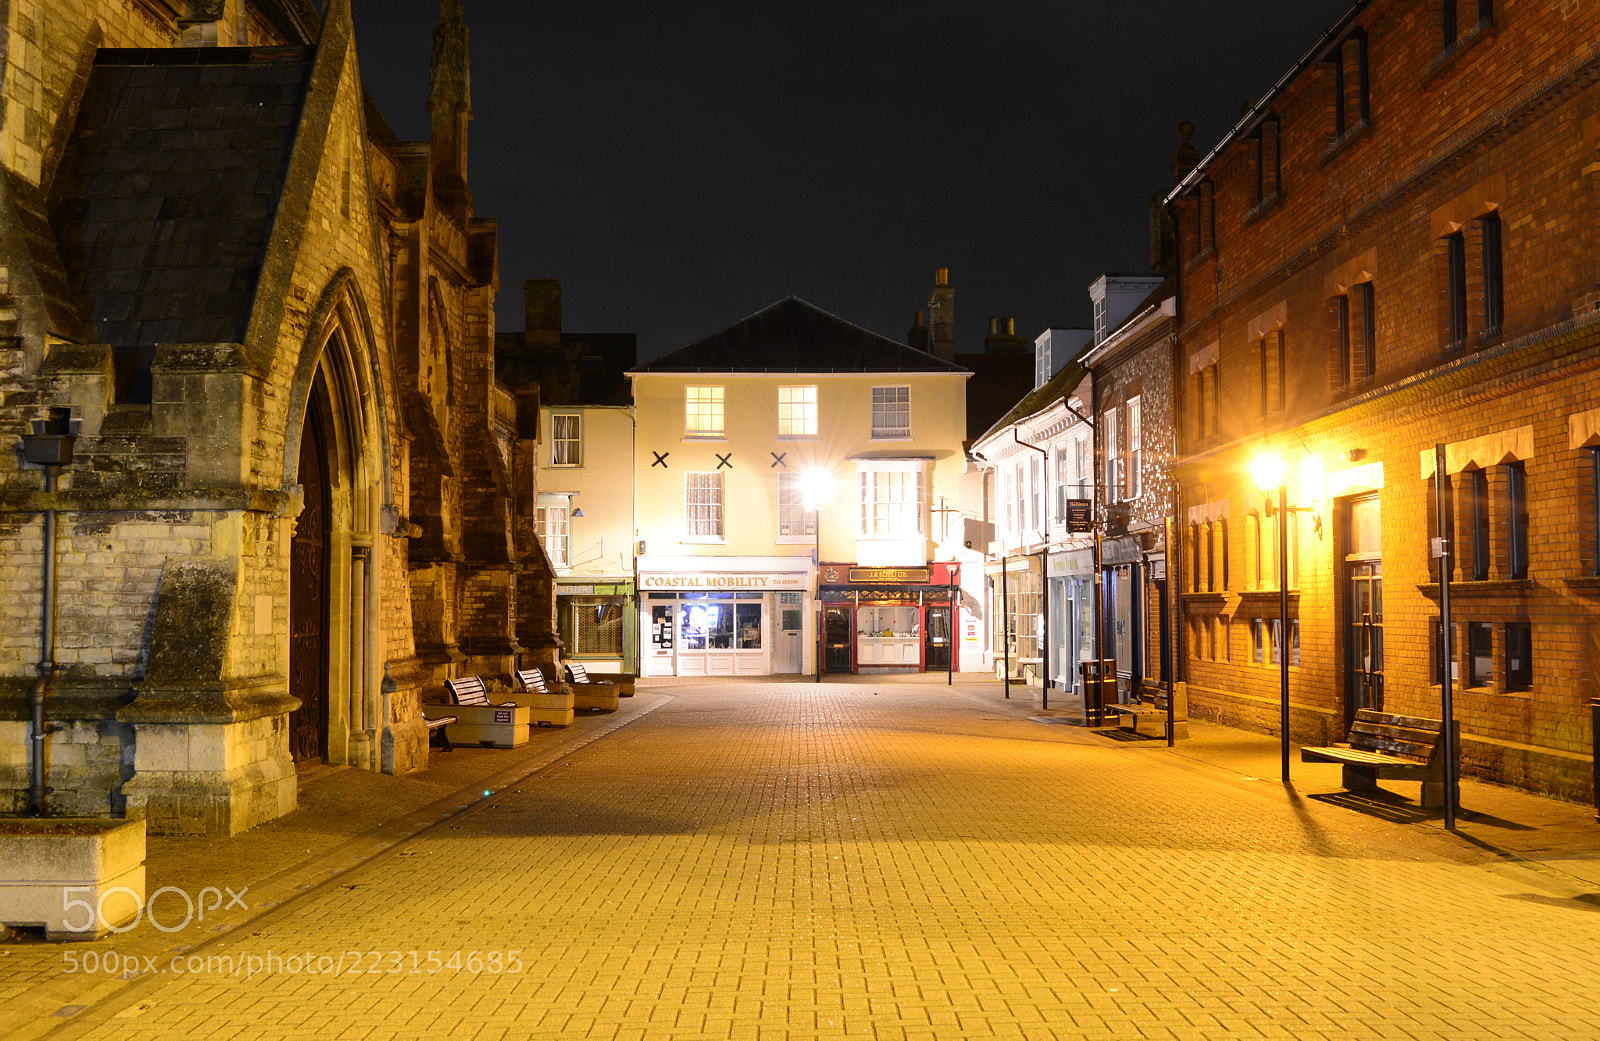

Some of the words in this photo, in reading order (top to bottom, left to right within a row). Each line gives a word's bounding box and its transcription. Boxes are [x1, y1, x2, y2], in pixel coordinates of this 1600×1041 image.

[645, 576, 703, 587] COASTAL
[706, 576, 768, 587] MOBILITY
[556, 585, 593, 593] EWELLERS
